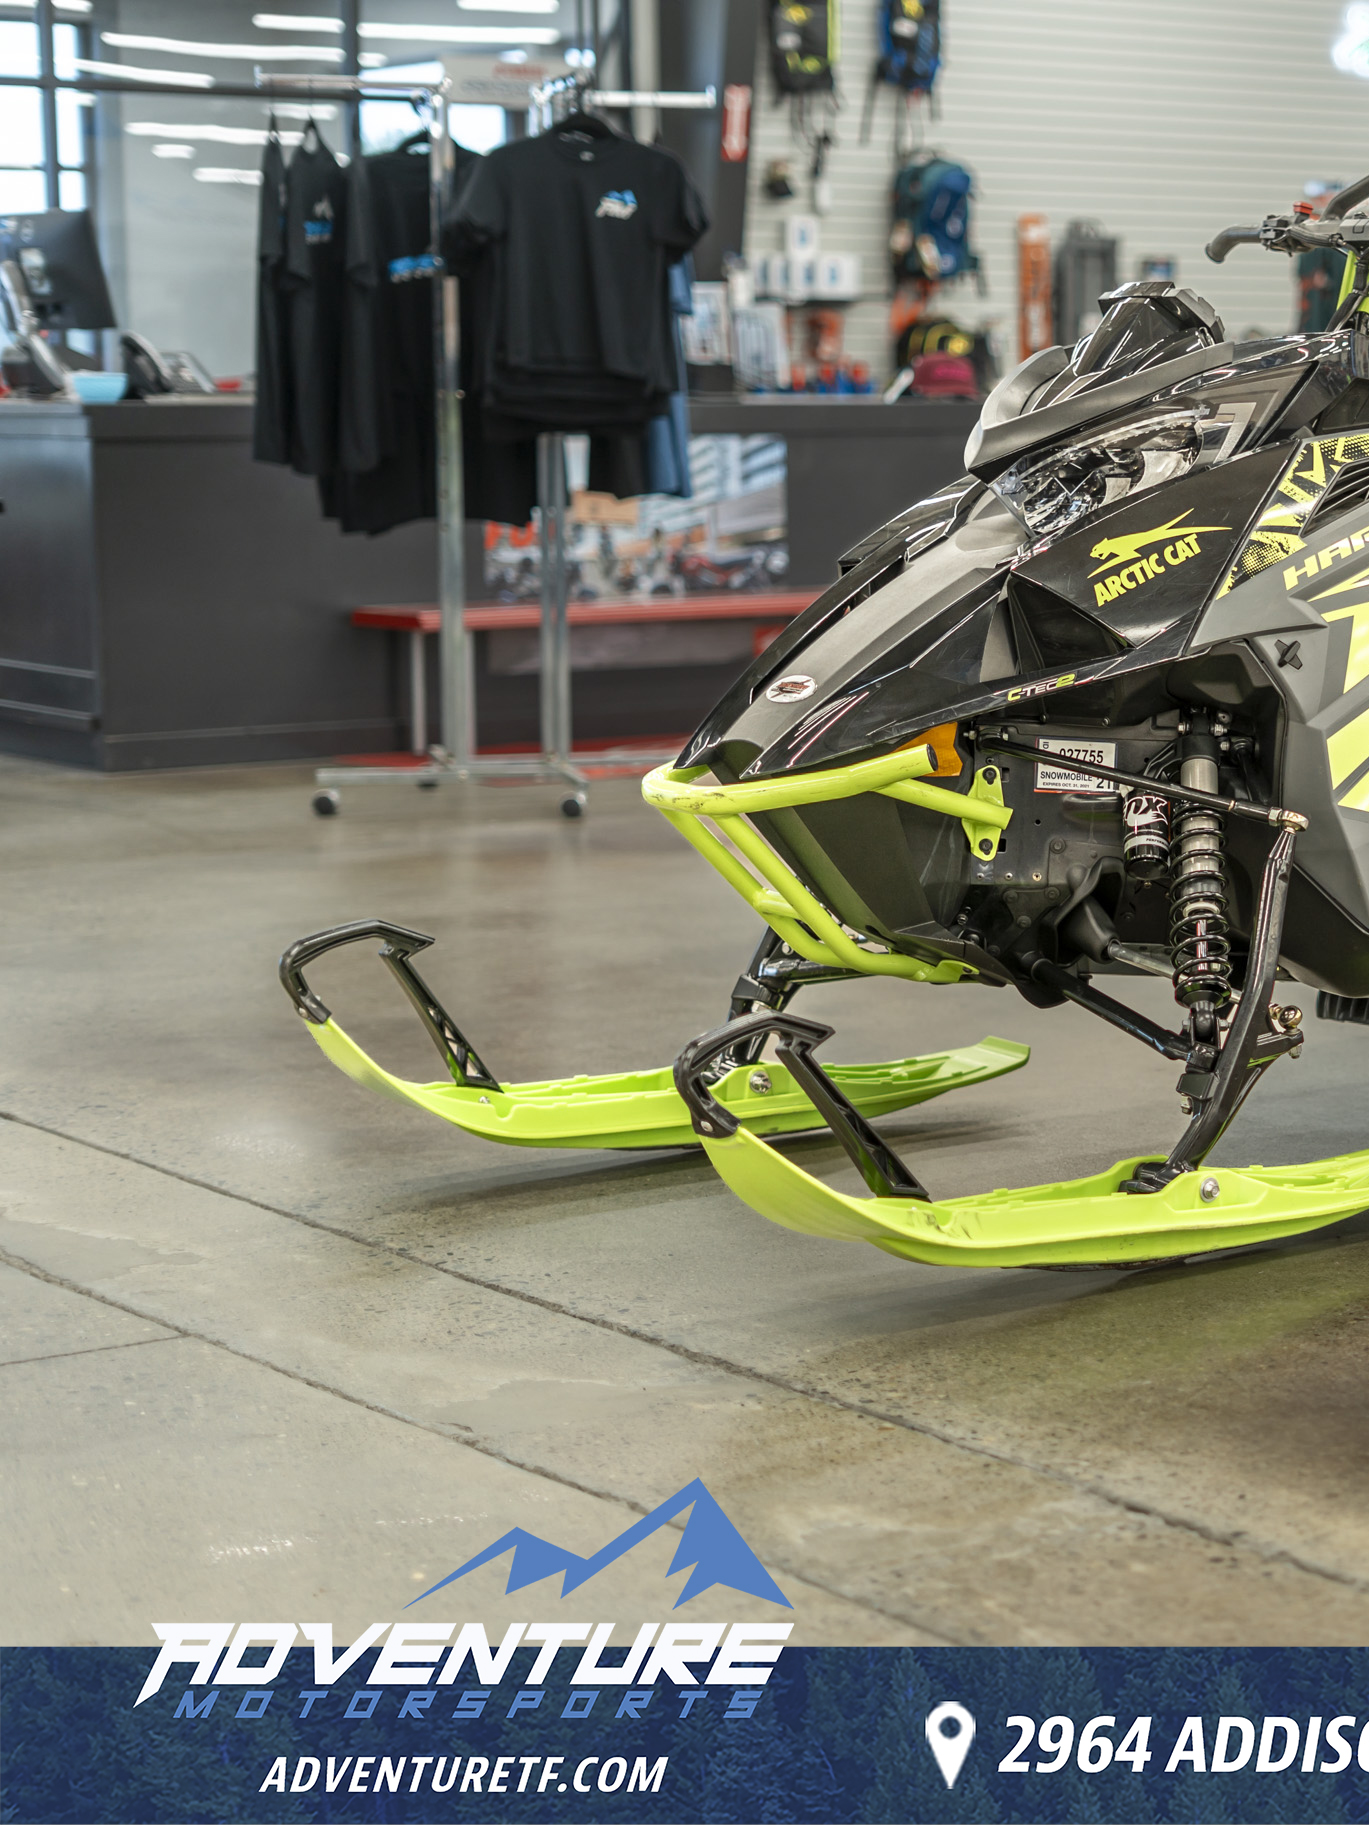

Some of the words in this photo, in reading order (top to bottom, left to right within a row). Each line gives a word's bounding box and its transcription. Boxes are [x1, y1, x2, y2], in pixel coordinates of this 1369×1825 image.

[1093, 552, 1166, 607] ARCTIC
[1163, 533, 1202, 566] CAT
[1060, 748, 1104, 764] 027755
[1040, 770, 1093, 782] SNOWMOBILE
[1123, 796, 1168, 827] OX
